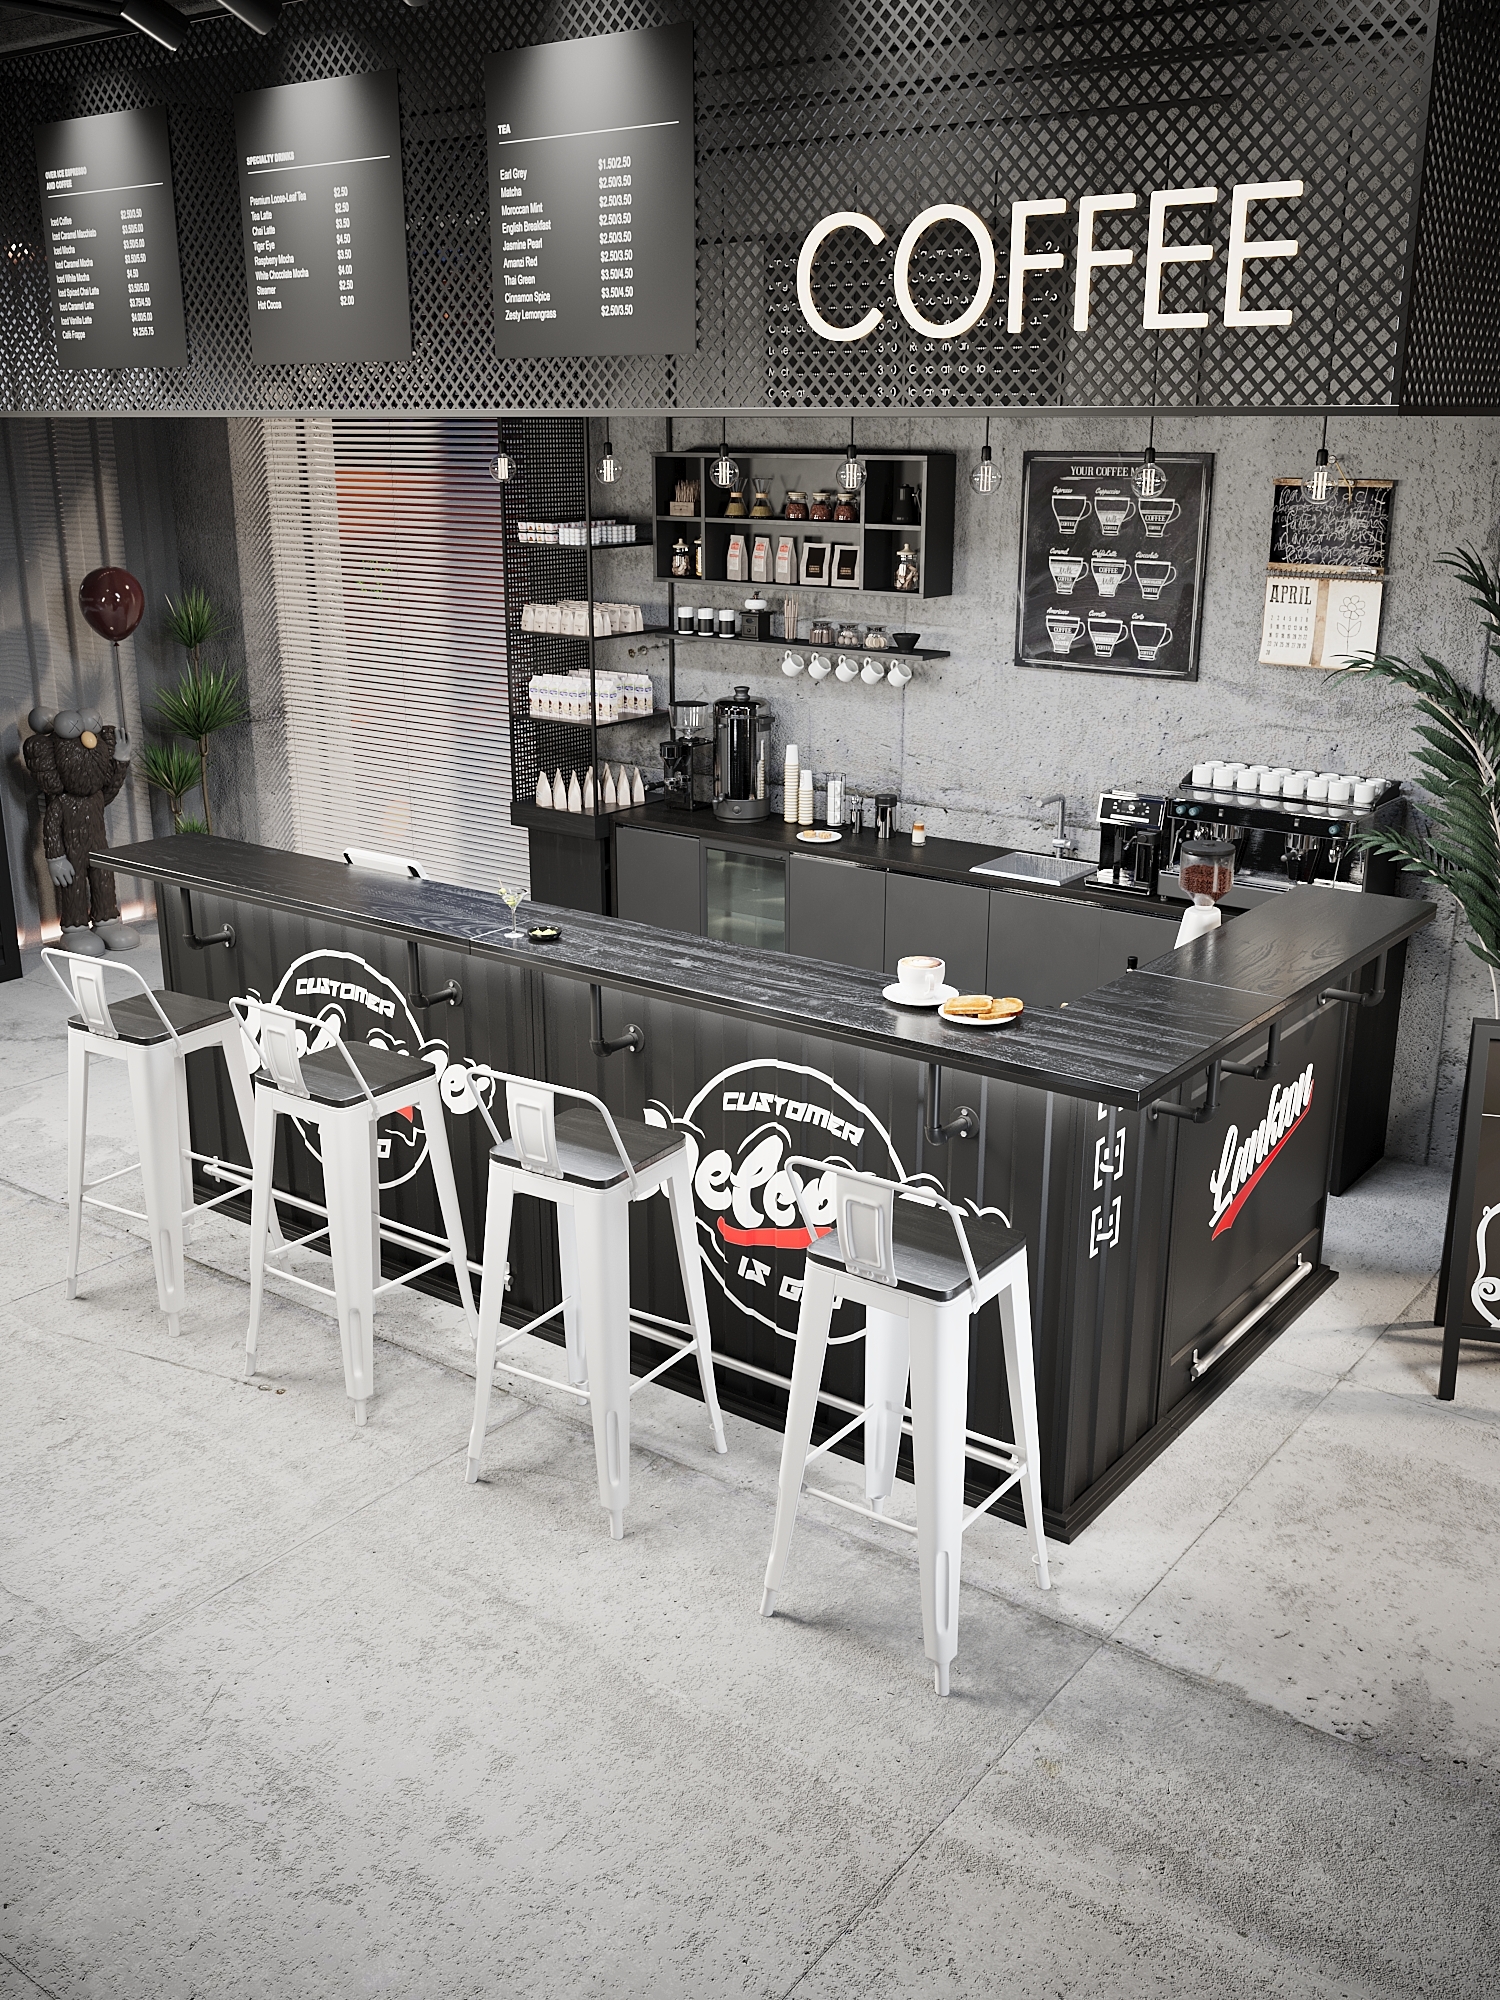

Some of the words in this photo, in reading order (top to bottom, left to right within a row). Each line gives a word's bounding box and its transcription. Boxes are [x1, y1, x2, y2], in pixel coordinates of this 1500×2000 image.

[498, 124, 511, 134] TEA
[247, 154, 273, 165] SPECIALTY
[274, 151, 294, 162] DRINKS
[45, 170, 57, 179] OVER
[65, 166, 87, 177] ESPRESSO
[500, 169, 512, 180] Earl
[513, 168, 527, 180] Grey
[598, 156, 631, 171] $1.50/2.50
[47, 182, 55, 190] AND
[56, 179, 72, 189] COFFEE
[501, 186, 522, 198] Matcha
[599, 175, 631, 189] $2.50/3.50
[250, 195, 270, 206] Premium
[297, 191, 306, 201] Tea
[334, 186, 348, 198] $2.50
[501, 204, 529, 216] Moroccan
[530, 202, 543, 213] Mint
[599, 194, 632, 208] $2.50/3.50
[251, 211, 260, 221] Tea
[260, 210, 272, 220] Latte
[335, 202, 349, 214] $2.50
[50, 218, 59, 226] Iced
[59, 216, 72, 226] Coffee
[252, 226, 263, 236] Chai
[263, 225, 275, 235] Latte
[336, 218, 350, 229] $3.50
[502, 222, 523, 235] English
[524, 220, 551, 232] Breakfast
[599, 212, 631, 227] $2.50/3.50
[52, 232, 60, 240] Iced
[61, 230, 76, 240] Caramel
[253, 241, 265, 253] Tiger
[265, 240, 275, 252] Eye
[336, 233, 351, 245] $4.50
[503, 239, 526, 251] Jasmine
[527, 238, 542, 249] Pearl
[599, 231, 631, 245] $2.50/3.50
[53, 246, 62, 255] Iced
[62, 245, 75, 254] Mocha
[254, 256, 278, 267] Raspberry
[278, 254, 294, 264] Mocha
[337, 249, 352, 260] $3.50
[503, 257, 524, 268] Amanzi
[525, 256, 538, 267] Red
[600, 249, 633, 263] $2.50/3.50
[55, 261, 63, 269] Iced
[64, 259, 79, 268] Caramel
[80, 258, 93, 267] Mocha
[797, 180, 1304, 342] COFFEE
[56, 275, 65, 283] Iced
[76, 273, 90, 282] Mocha
[255, 271, 269, 280] White
[269, 269, 292, 280] Chocolate
[292, 268, 309, 278] Mocha
[338, 264, 352, 276] $4.00
[504, 275, 516, 285] Thai
[518, 274, 535, 285] Green
[601, 267, 633, 281] $3.50/4.50
[58, 289, 66, 297] Iced
[257, 286, 276, 295] Steamer
[339, 280, 353, 291] $2.50
[505, 292, 533, 303] Cinnamon
[534, 291, 550, 304] Spice
[601, 286, 633, 299] $3.50/4.50
[59, 302, 68, 311] Iced
[68, 302, 84, 310] Caramel
[258, 300, 266, 310] Hot
[267, 300, 282, 309] Cocoa
[340, 295, 354, 306] $2.00
[61, 317, 69, 325] Iced
[505, 310, 521, 322] Zesty
[522, 309, 556, 321] Lemongrass
[601, 304, 633, 317] $2.50/3.50
[1071, 466, 1093, 476] YOUR
[1096, 467, 1128, 476] COFFEE
[1270, 585, 1311, 604] APRIL
[296, 977, 395, 1018] CUSTOMER
[722, 1092, 865, 1146] CUSTOMER
[737, 1256, 771, 1286] IS
